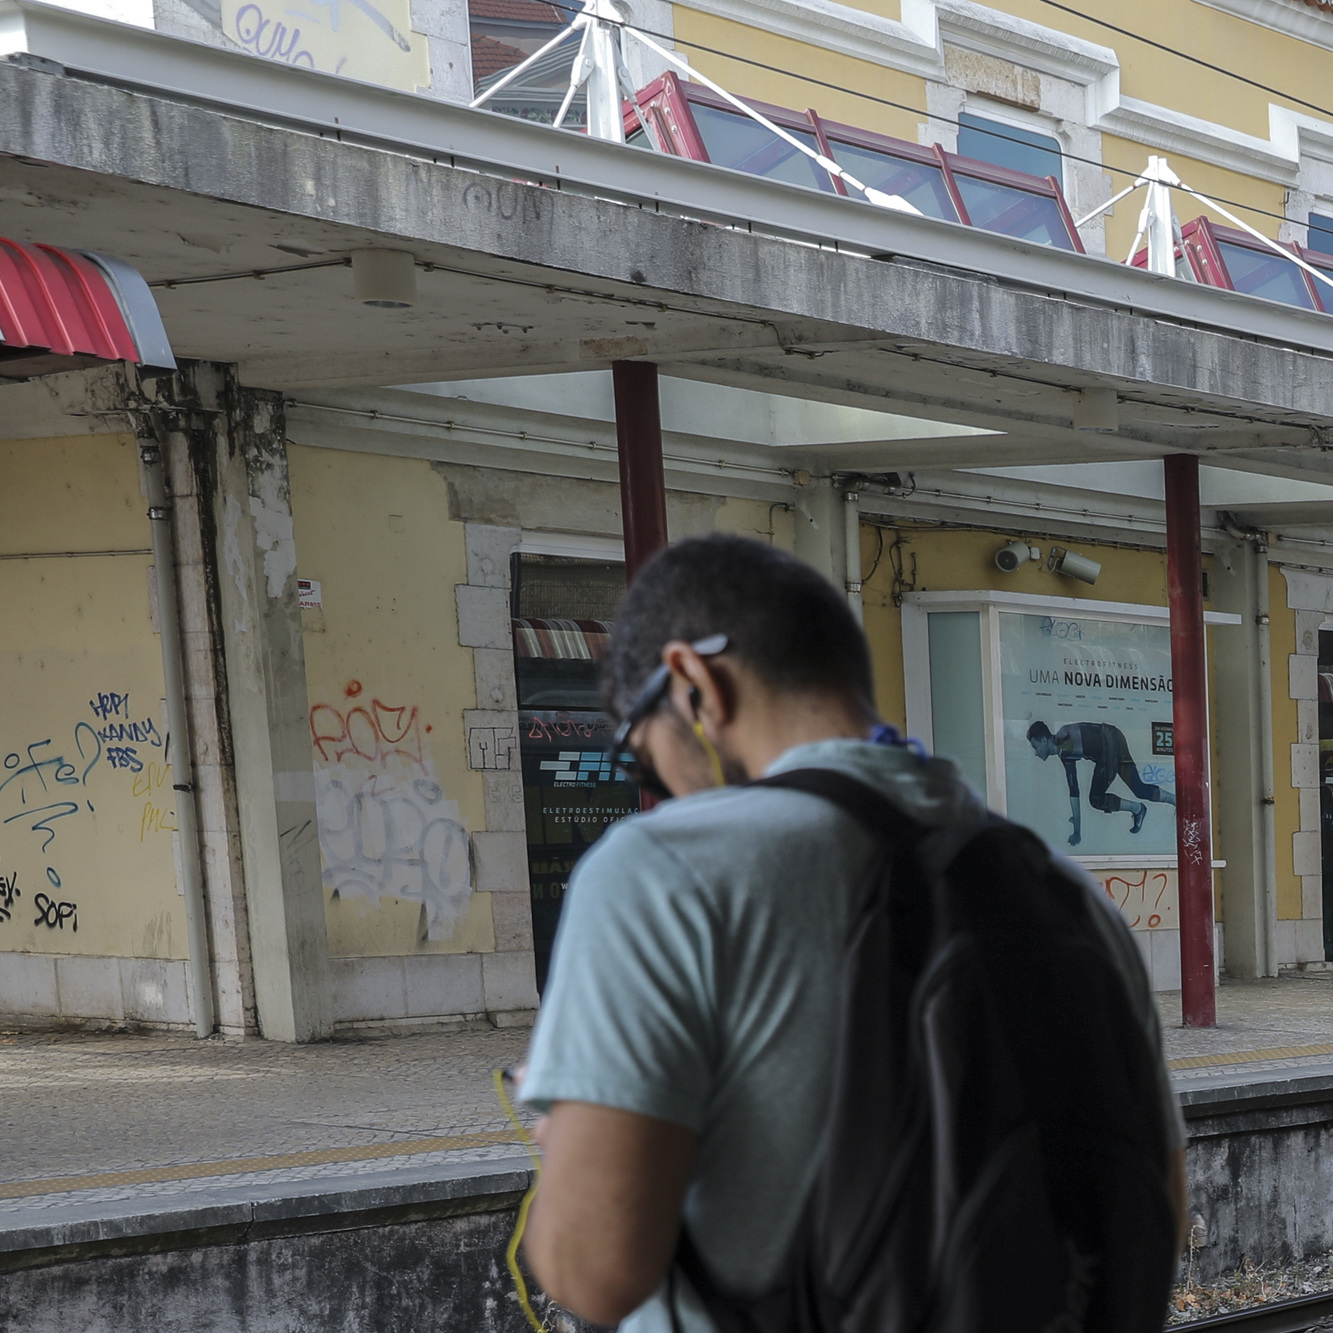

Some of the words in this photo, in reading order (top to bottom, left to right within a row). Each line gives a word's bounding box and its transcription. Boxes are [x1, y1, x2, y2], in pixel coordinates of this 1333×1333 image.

[1063, 657, 1139, 671] ELECTROFITNESS
[1029, 669, 1060, 685] UMA
[1064, 671, 1102, 688] NOVA
[1156, 731, 1173, 747] 25
[543, 807, 639, 815] ELETROESTIMULAÇ
[554, 815, 598, 823] ESTÚDIO
